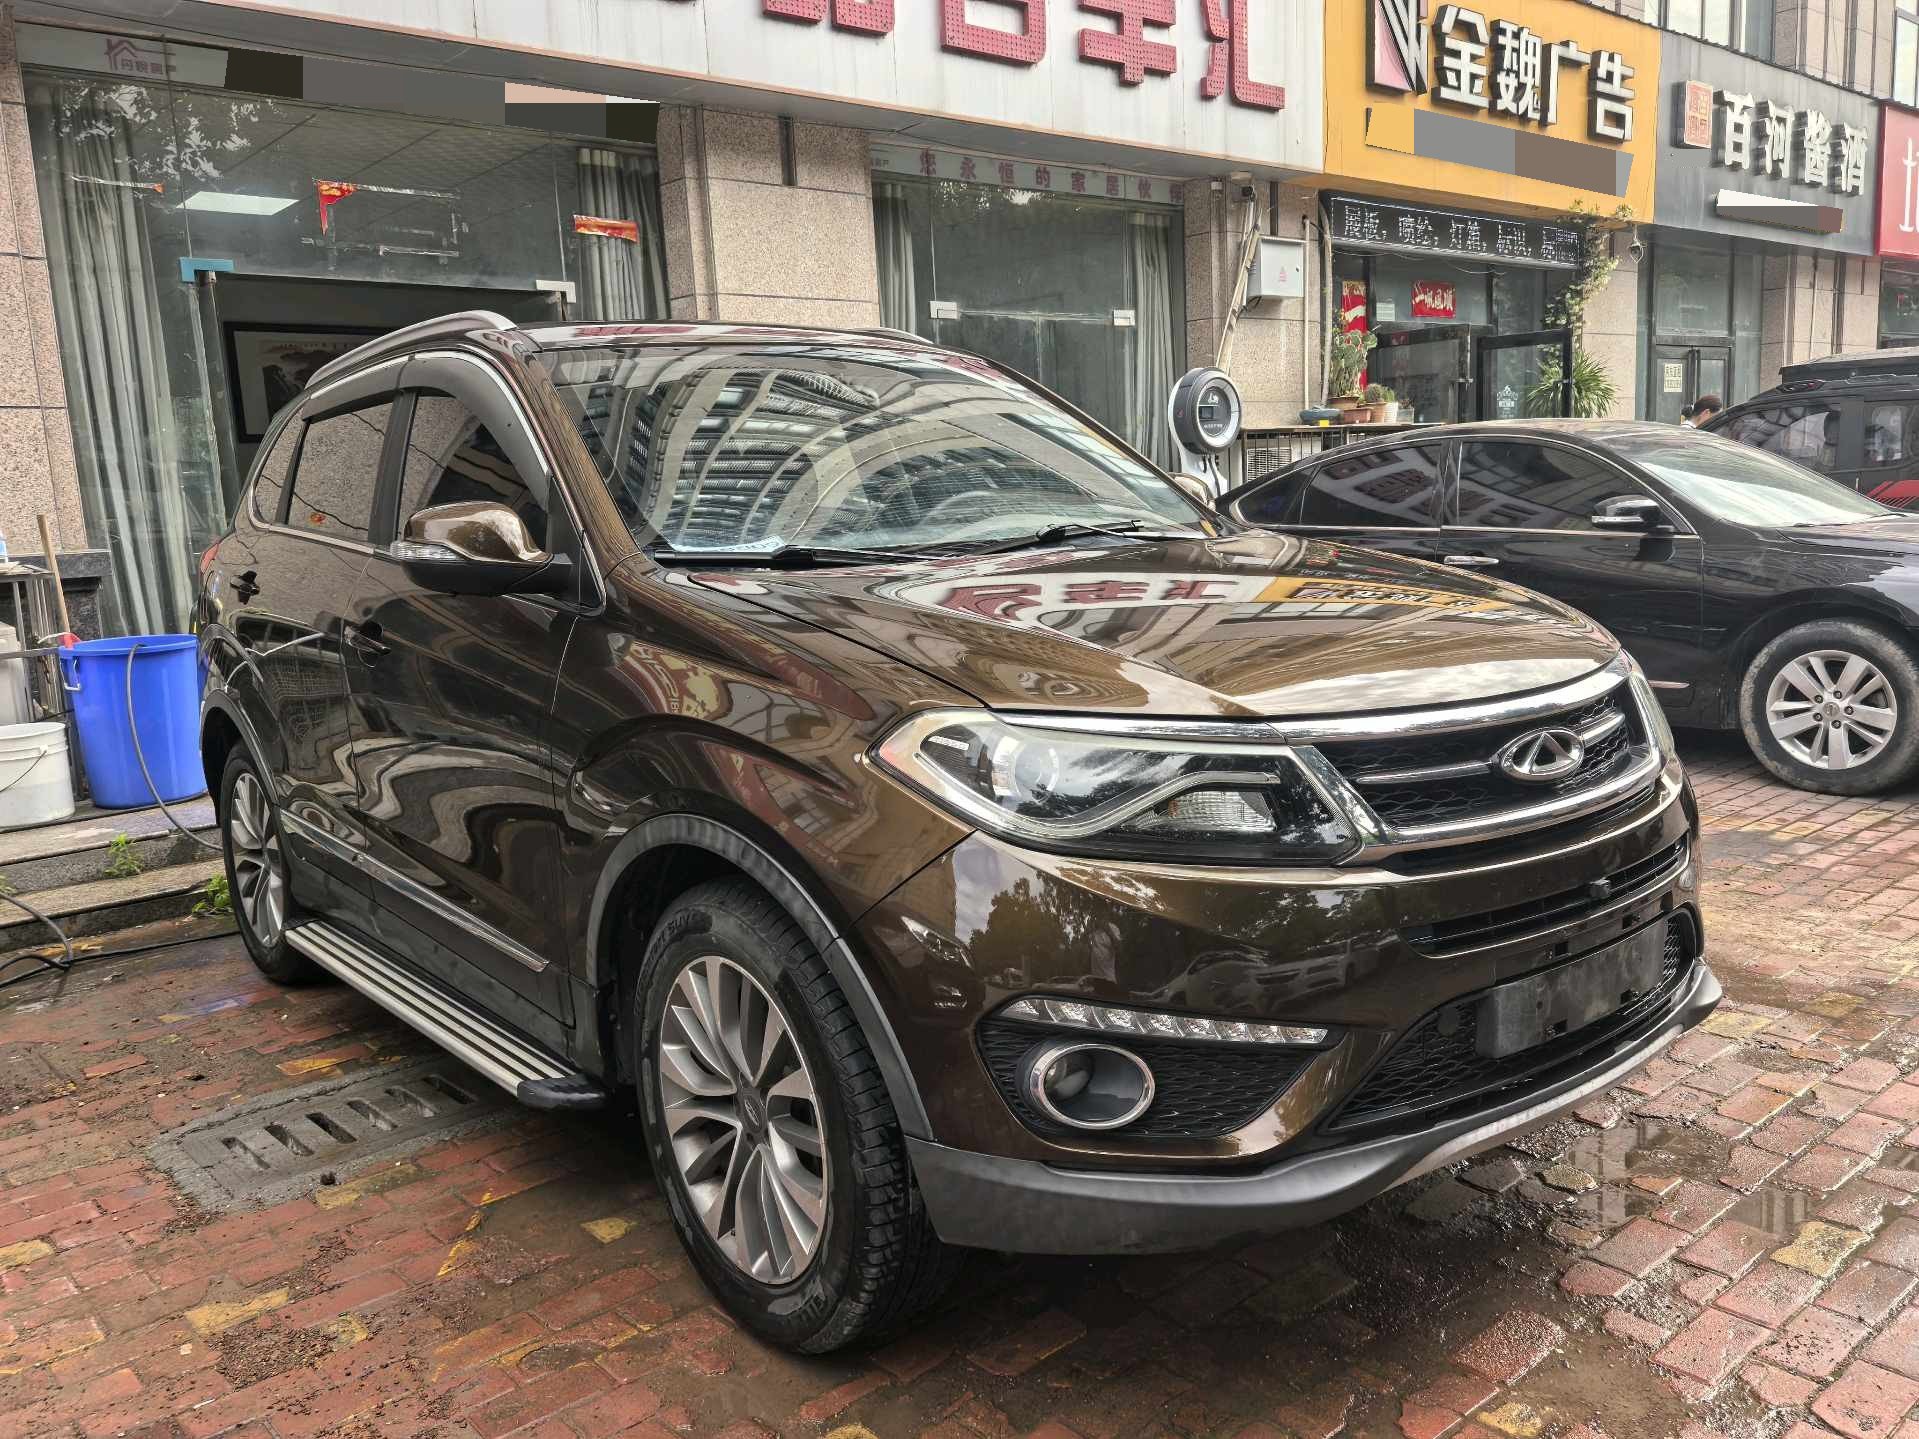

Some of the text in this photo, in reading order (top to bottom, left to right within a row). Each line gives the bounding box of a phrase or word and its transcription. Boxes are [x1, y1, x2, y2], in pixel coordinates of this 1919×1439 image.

[1432, 3, 1635, 143] 金魏广告
[1715, 88, 1868, 196] 百河酱酒
